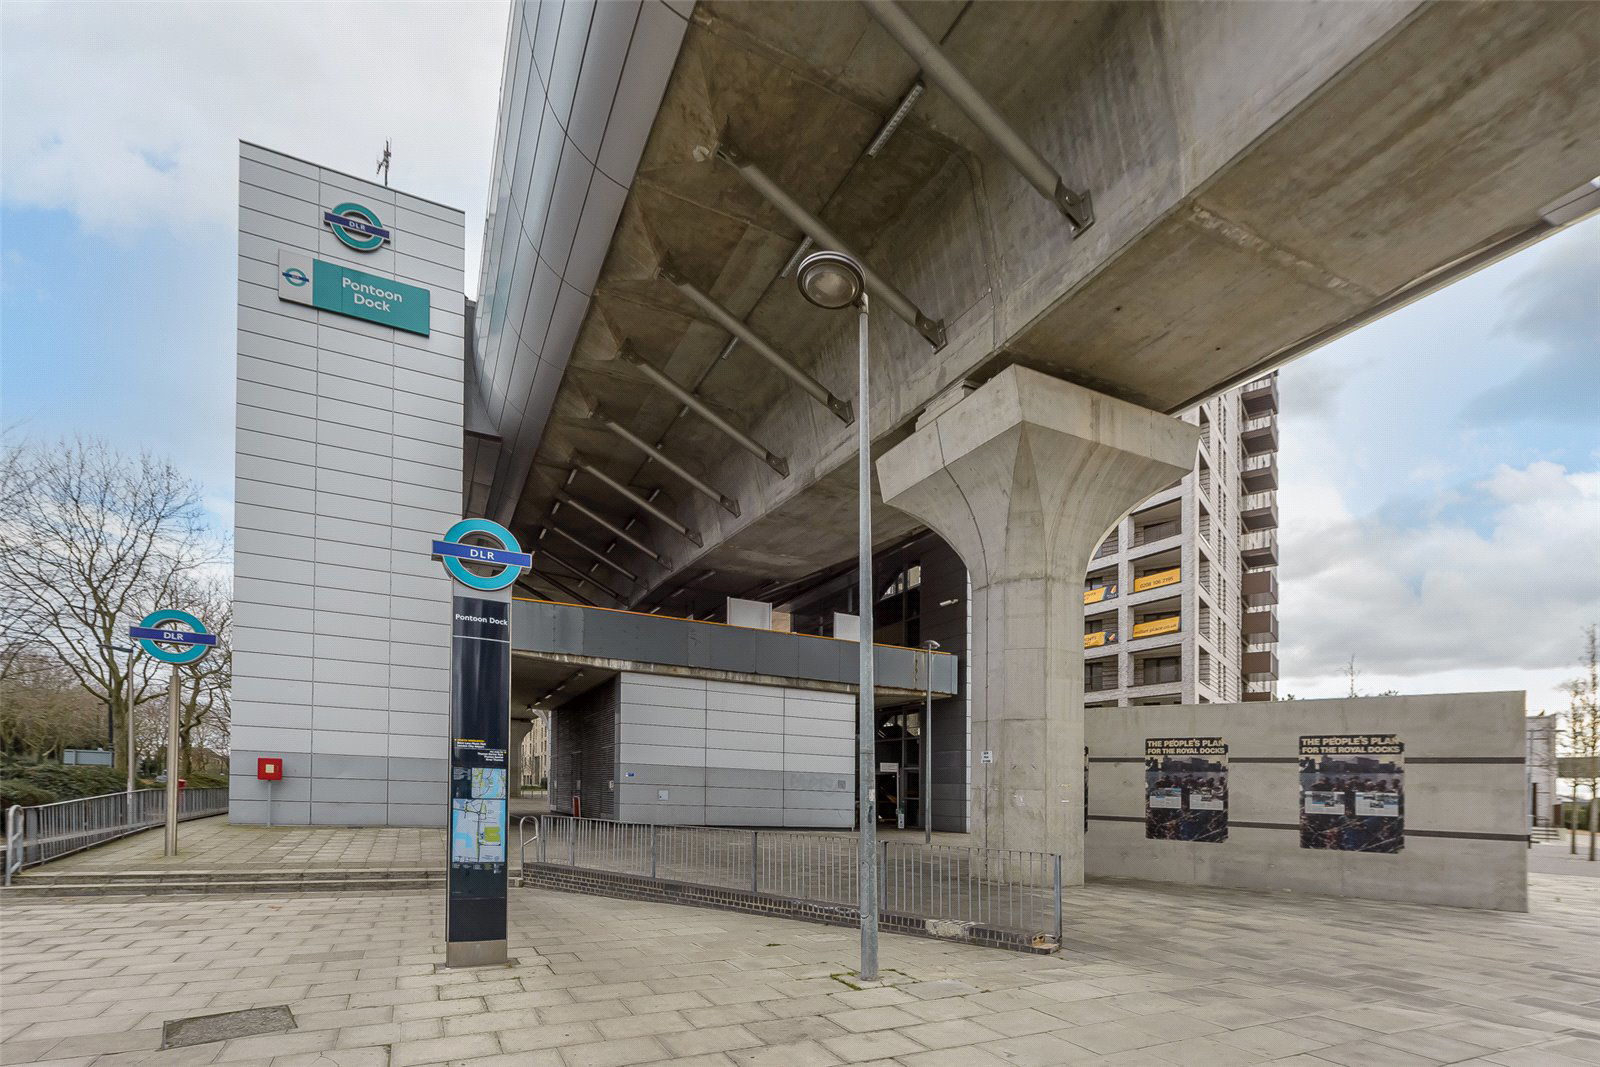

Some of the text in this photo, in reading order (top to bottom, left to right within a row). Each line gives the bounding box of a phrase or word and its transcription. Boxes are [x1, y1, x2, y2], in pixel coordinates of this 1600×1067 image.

[348, 220, 367, 231] DLR
[342, 276, 403, 303] Pontoon
[353, 293, 391, 313] Dock
[470, 549, 495, 560] DLR
[455, 613, 508, 626] Pontoon Dock
[163, 631, 184, 641] DLR
[1163, 739, 1201, 747] PEOPLE'S
[1301, 738, 1321, 746] THE
[1322, 737, 1368, 746] PEOPLE'S
